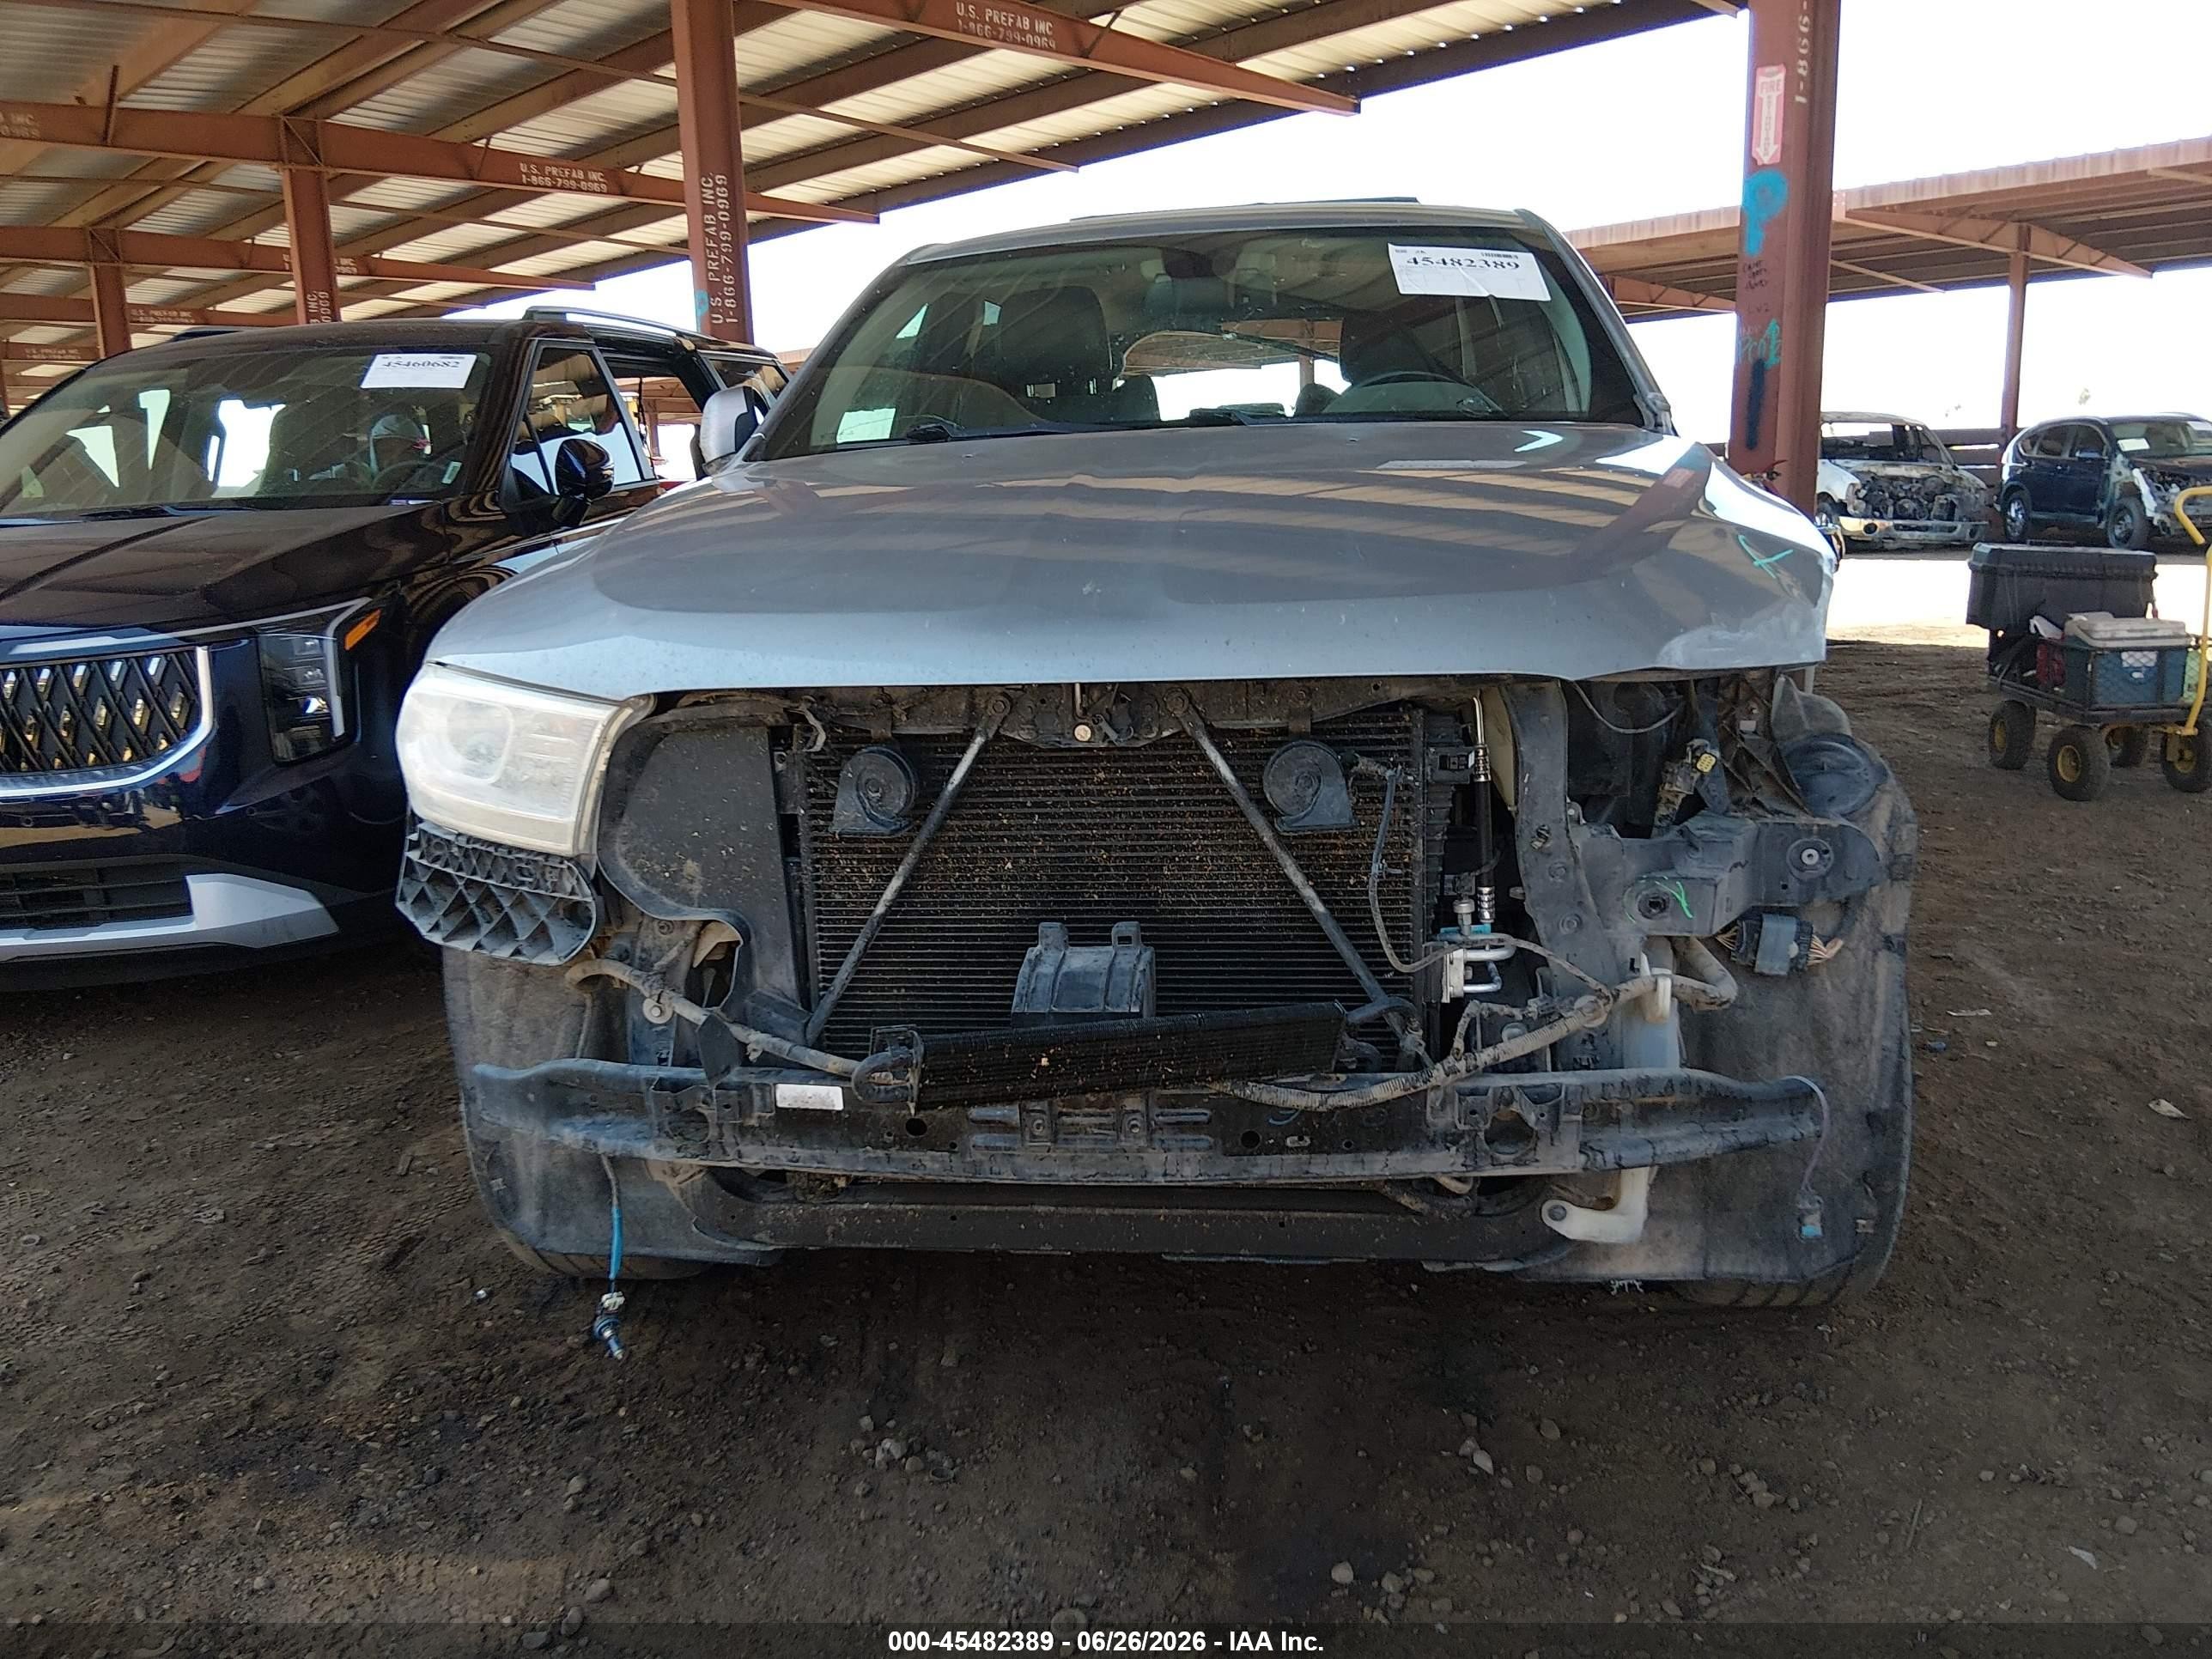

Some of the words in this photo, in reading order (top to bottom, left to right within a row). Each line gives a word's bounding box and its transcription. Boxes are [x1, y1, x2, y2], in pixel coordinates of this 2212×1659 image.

[956, 1, 980, 20] U.S.
[985, 8, 1030, 31] PREFAB
[520, 162, 541, 175] U.S.
[544, 166, 584, 180] PREFAB
[521, 173, 608, 193] 1-866-799-0969
[703, 214, 721, 282] PREFAB
[714, 174, 738, 324] 1-866-799-0969
[1407, 256, 1521, 270] 45482389
[382, 360, 461, 368] 45460682
